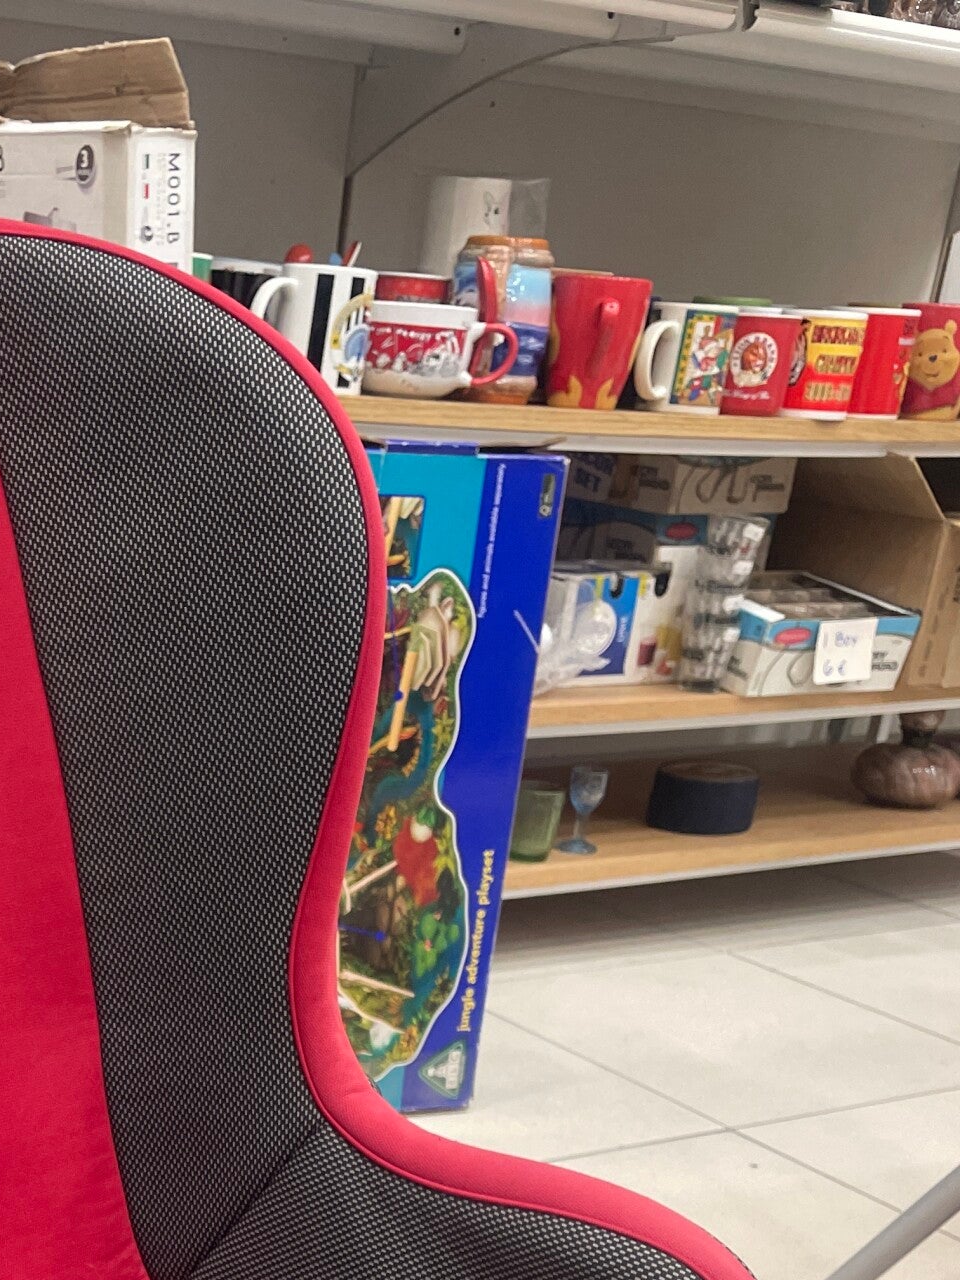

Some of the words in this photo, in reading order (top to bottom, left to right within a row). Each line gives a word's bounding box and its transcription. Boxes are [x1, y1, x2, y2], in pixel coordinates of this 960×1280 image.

[167, 152, 181, 244] M001.B
[457, 988, 475, 1032] jungle
[466, 908, 486, 985] adventure
[477, 849, 495, 906] playset
